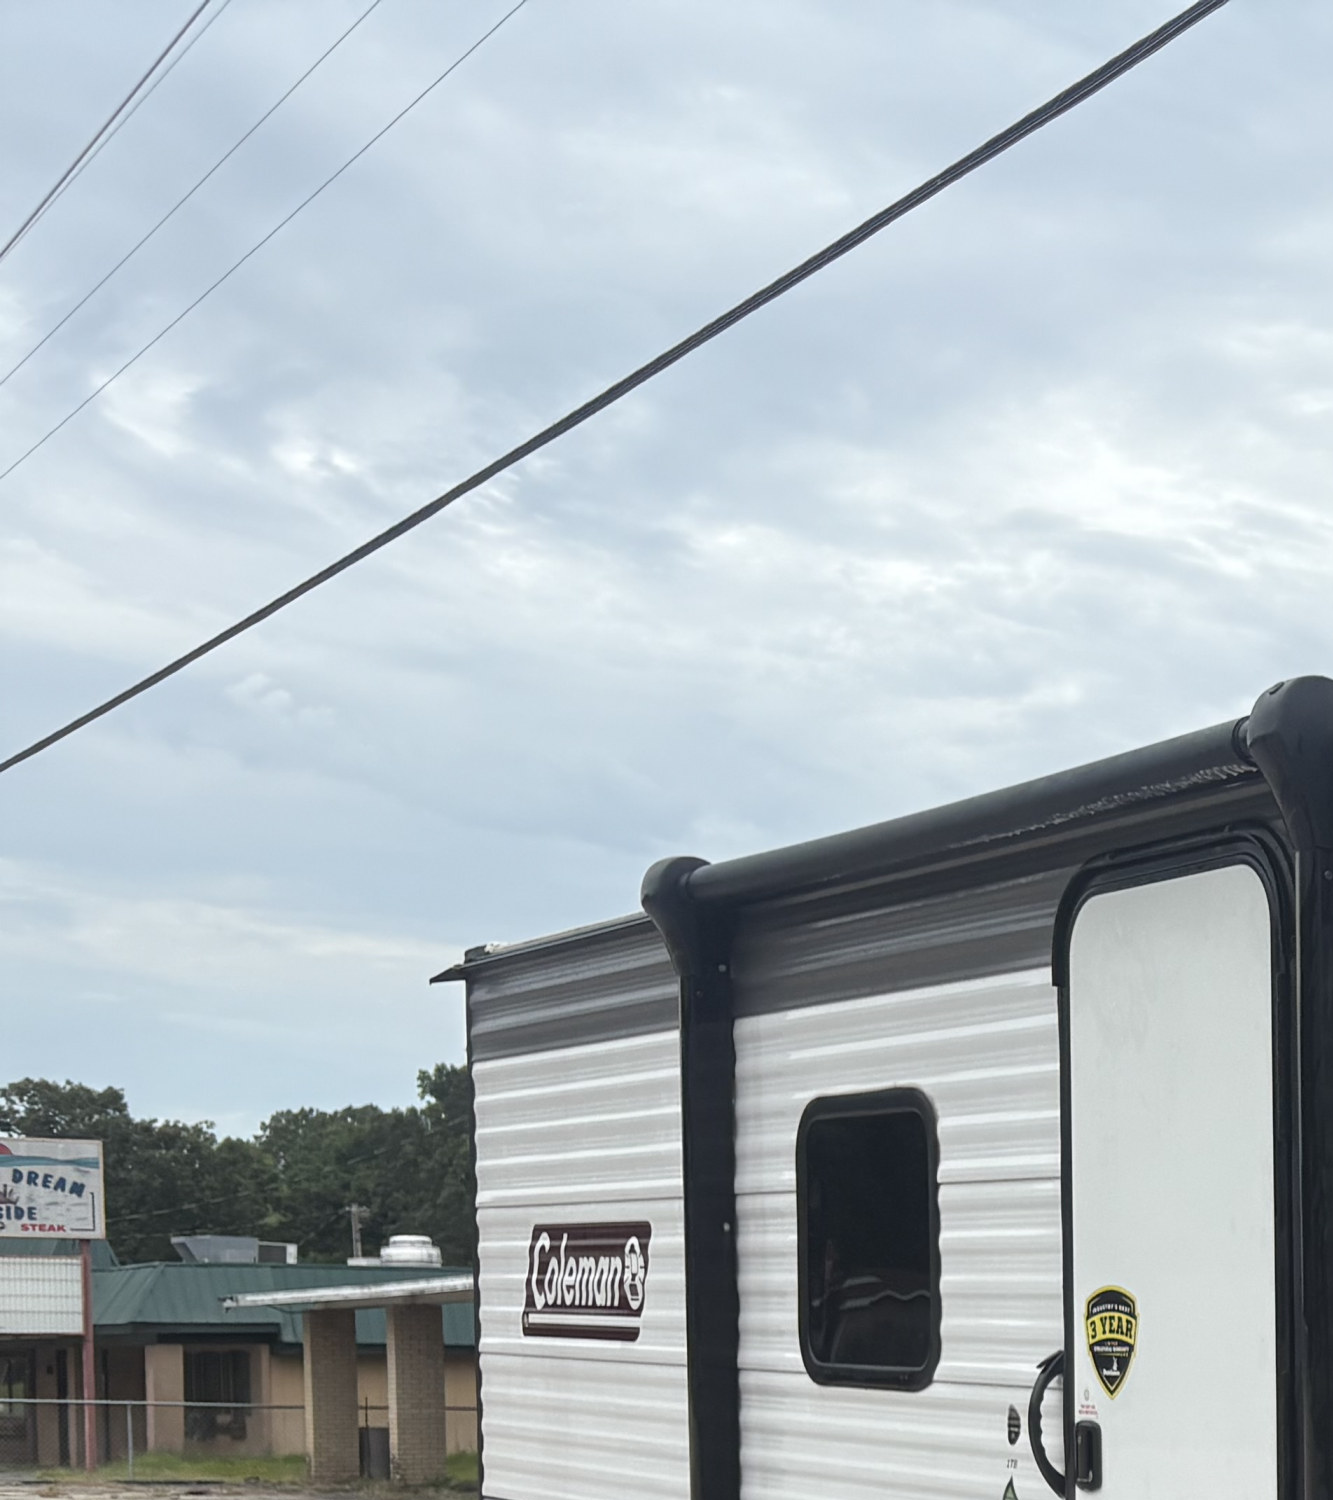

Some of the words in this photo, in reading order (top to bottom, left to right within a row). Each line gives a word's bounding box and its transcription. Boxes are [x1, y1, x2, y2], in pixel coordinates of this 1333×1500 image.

[11, 1168, 86, 1198] DREAM
[20, 1223, 67, 1232] STEAK
[531, 1231, 623, 1311] Coleman
[1089, 1319, 1098, 1340] 3
[1099, 1315, 1133, 1339] YEAR
